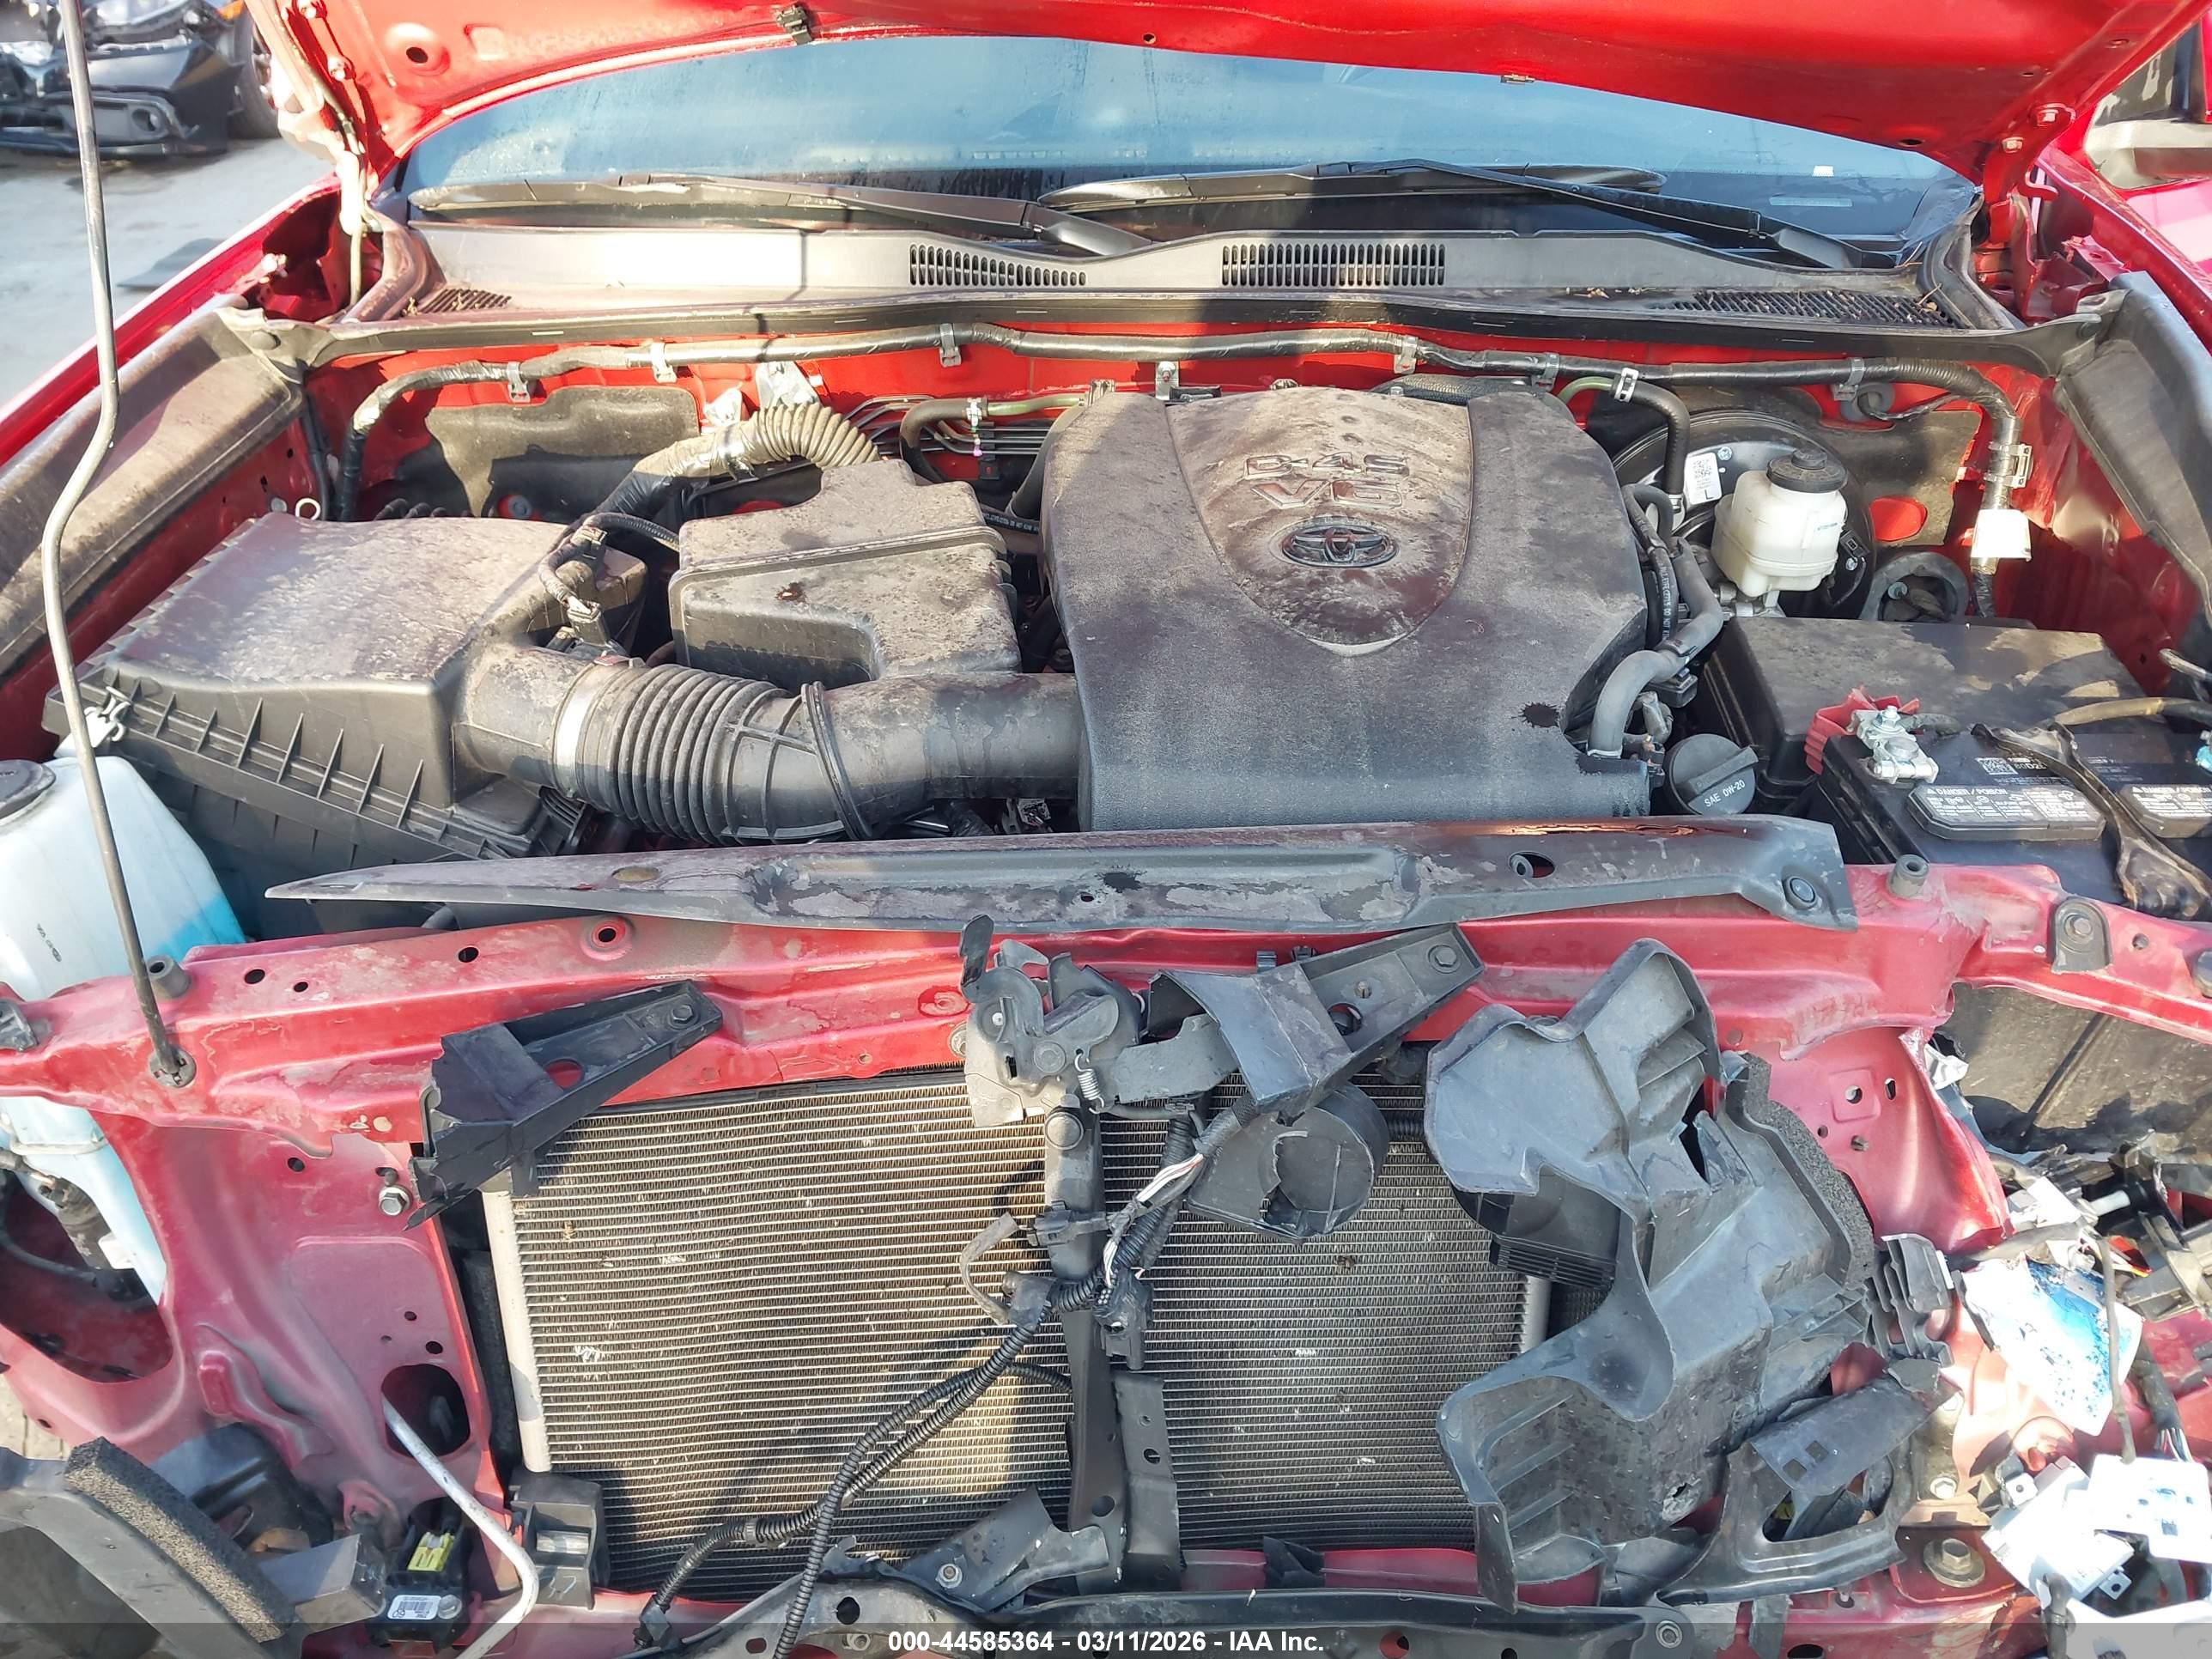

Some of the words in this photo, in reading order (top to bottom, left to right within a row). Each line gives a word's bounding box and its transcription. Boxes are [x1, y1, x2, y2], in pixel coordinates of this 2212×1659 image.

[1243, 451, 1411, 480] D-4S
[1251, 478, 1403, 509] V6
[1704, 793, 1722, 807] SAE
[1722, 779, 1746, 797] 0W-20
